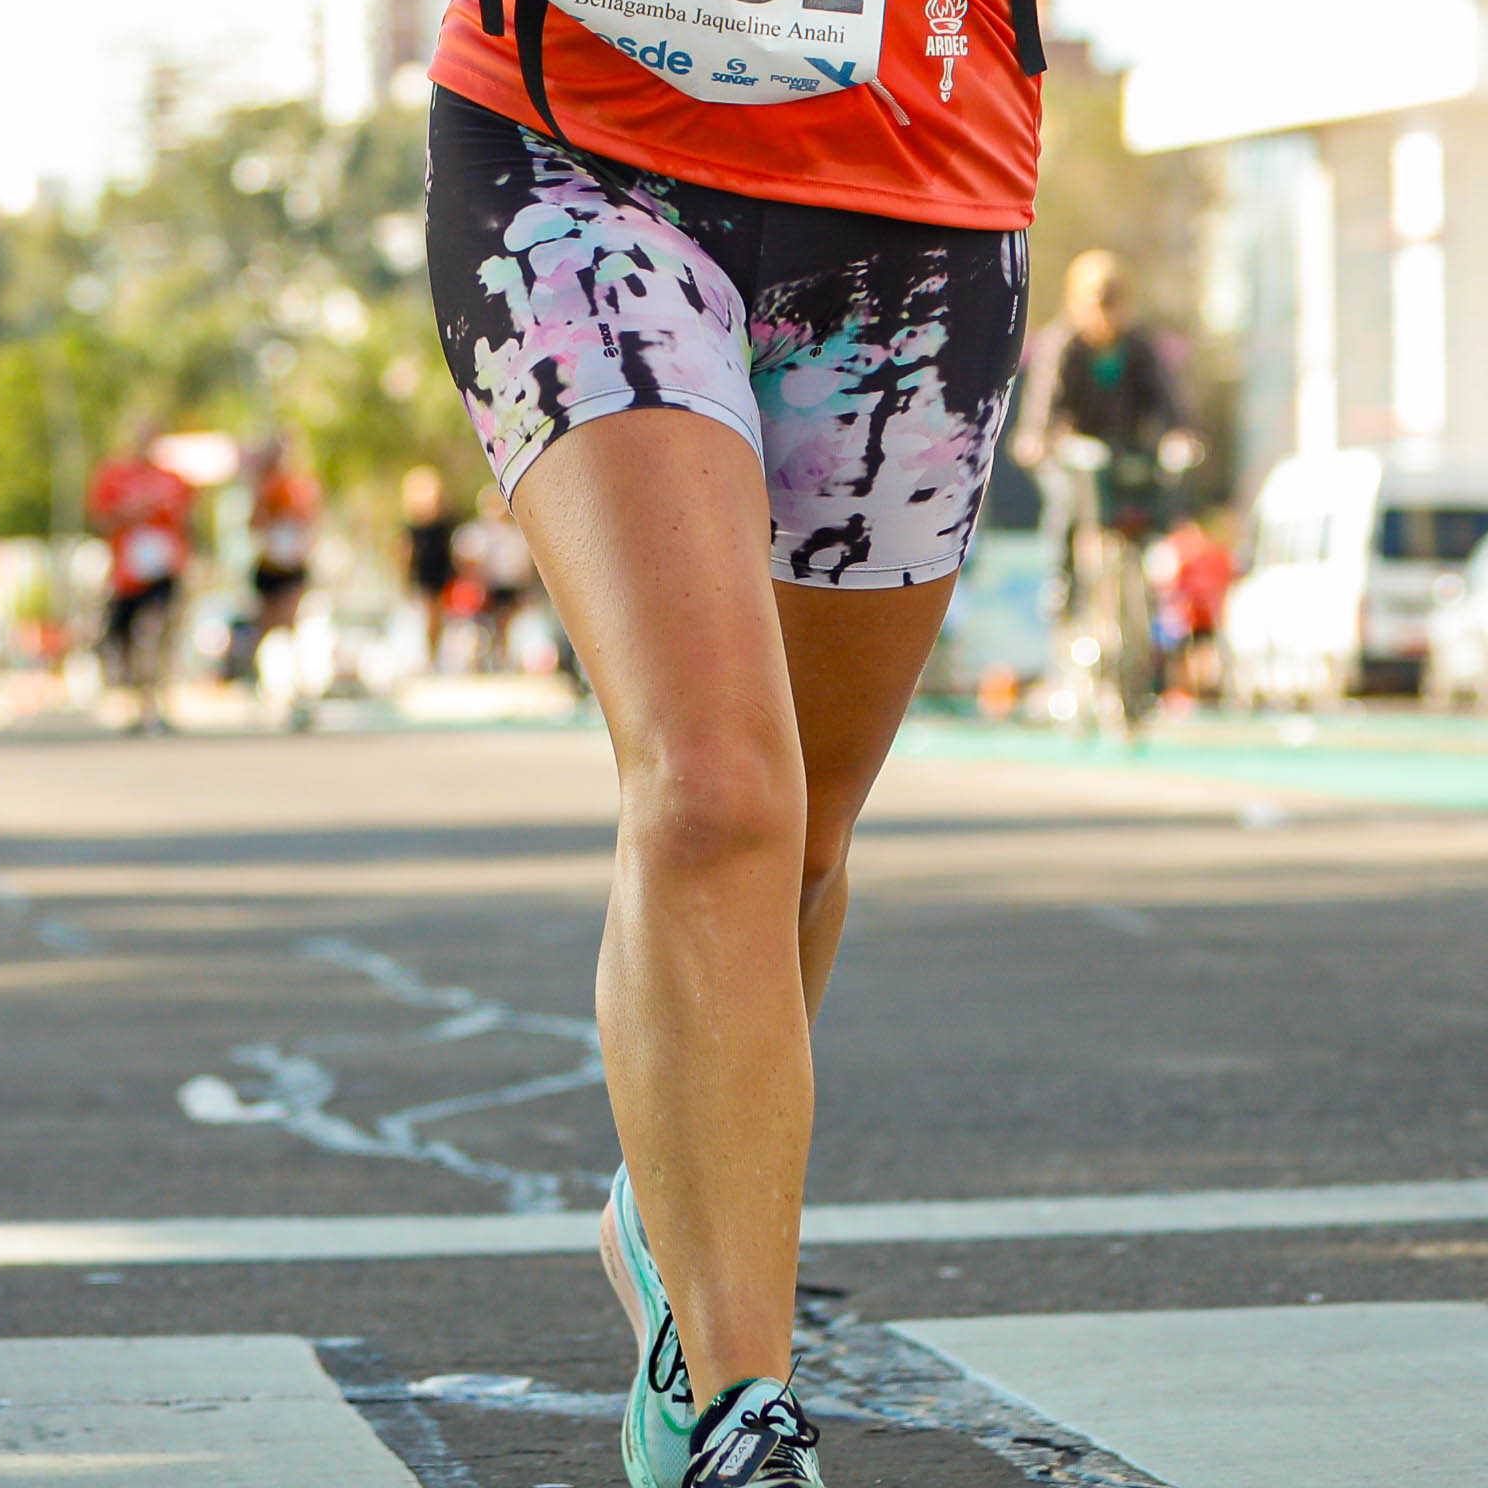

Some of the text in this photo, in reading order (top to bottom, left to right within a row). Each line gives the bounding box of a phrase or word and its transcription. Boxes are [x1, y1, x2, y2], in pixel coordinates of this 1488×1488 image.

[692, 8, 782, 38] Jaqueline
[787, 23, 847, 44] Anahi
[925, 35, 969, 57] ARDEC
[770, 74, 821, 86] POWER
